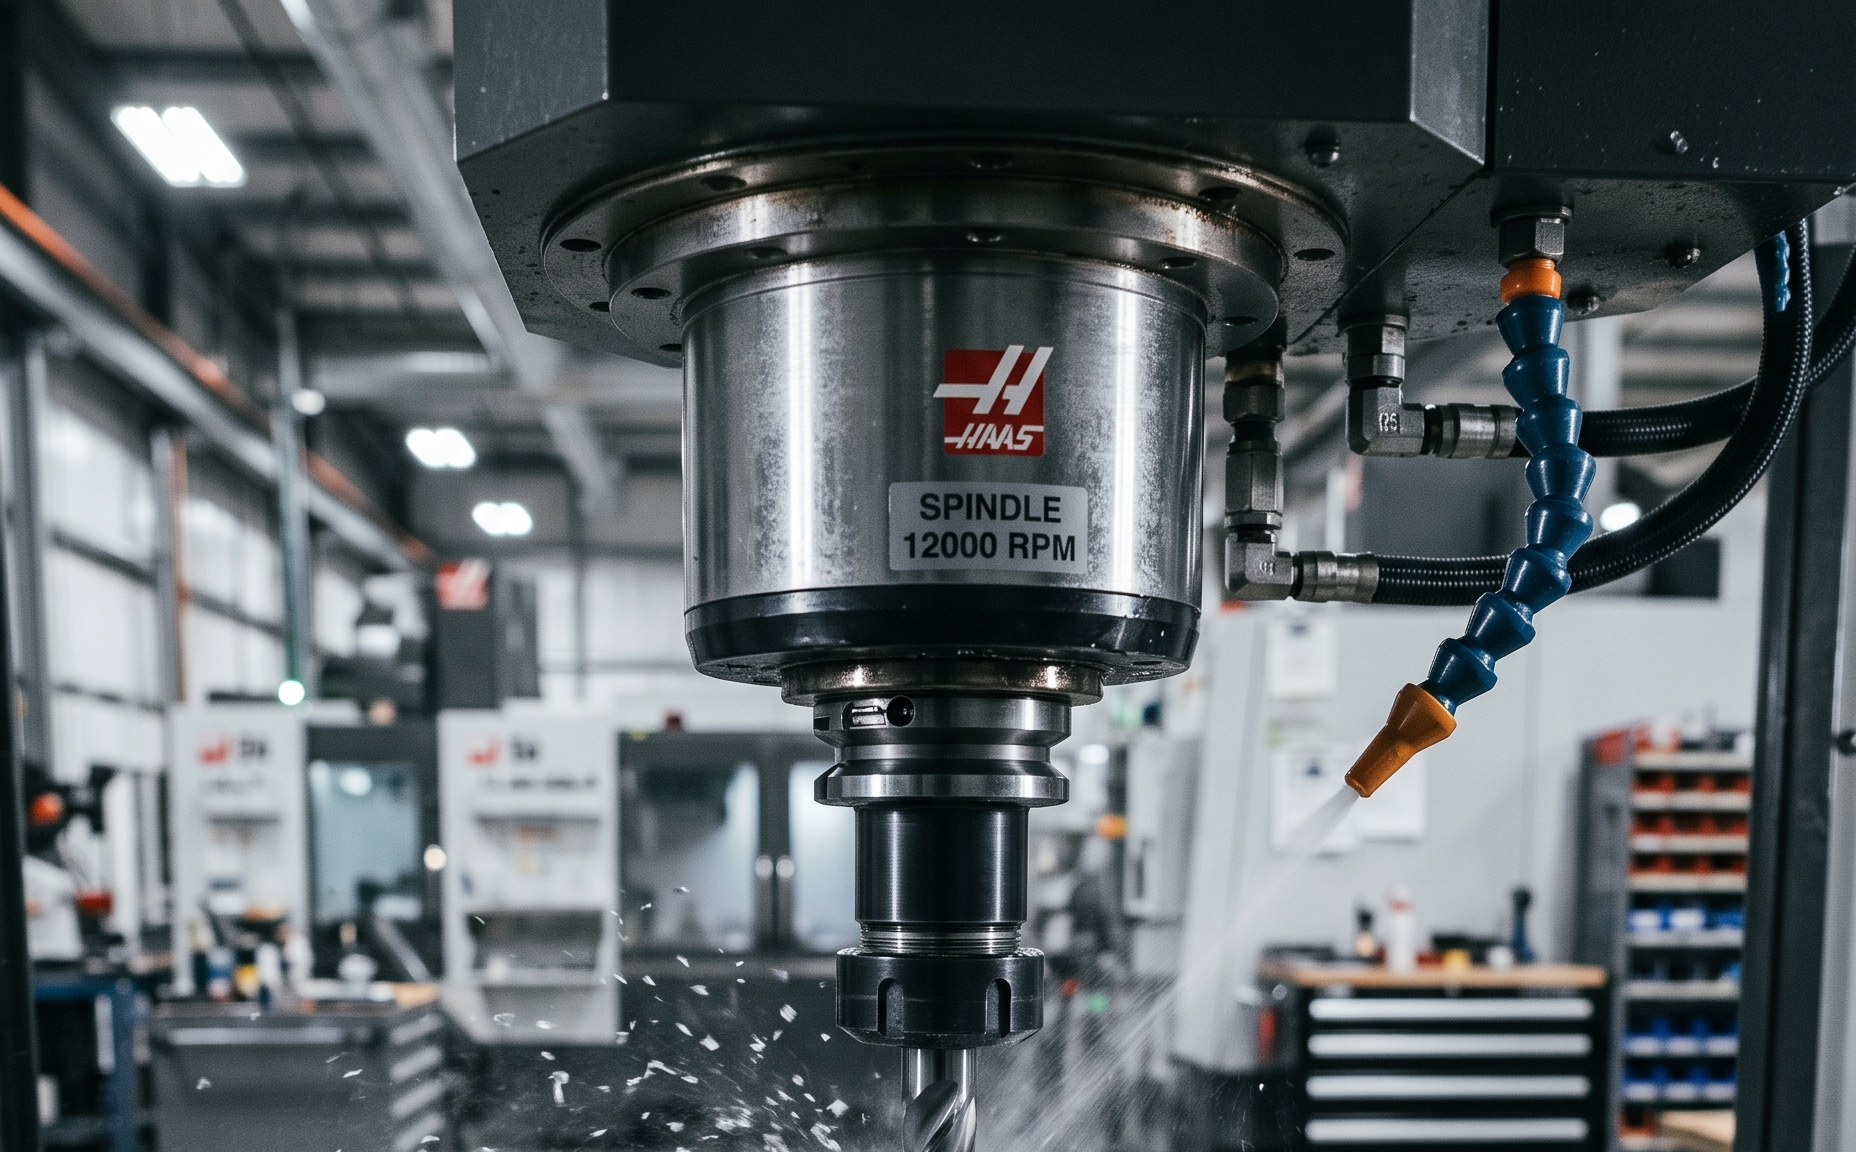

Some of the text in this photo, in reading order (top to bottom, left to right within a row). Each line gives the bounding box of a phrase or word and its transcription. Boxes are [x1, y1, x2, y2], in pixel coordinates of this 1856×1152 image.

[944, 423, 1044, 450] HAAS
[919, 493, 1062, 523] SPINDLE
[903, 532, 1076, 561] 12000 RPM
